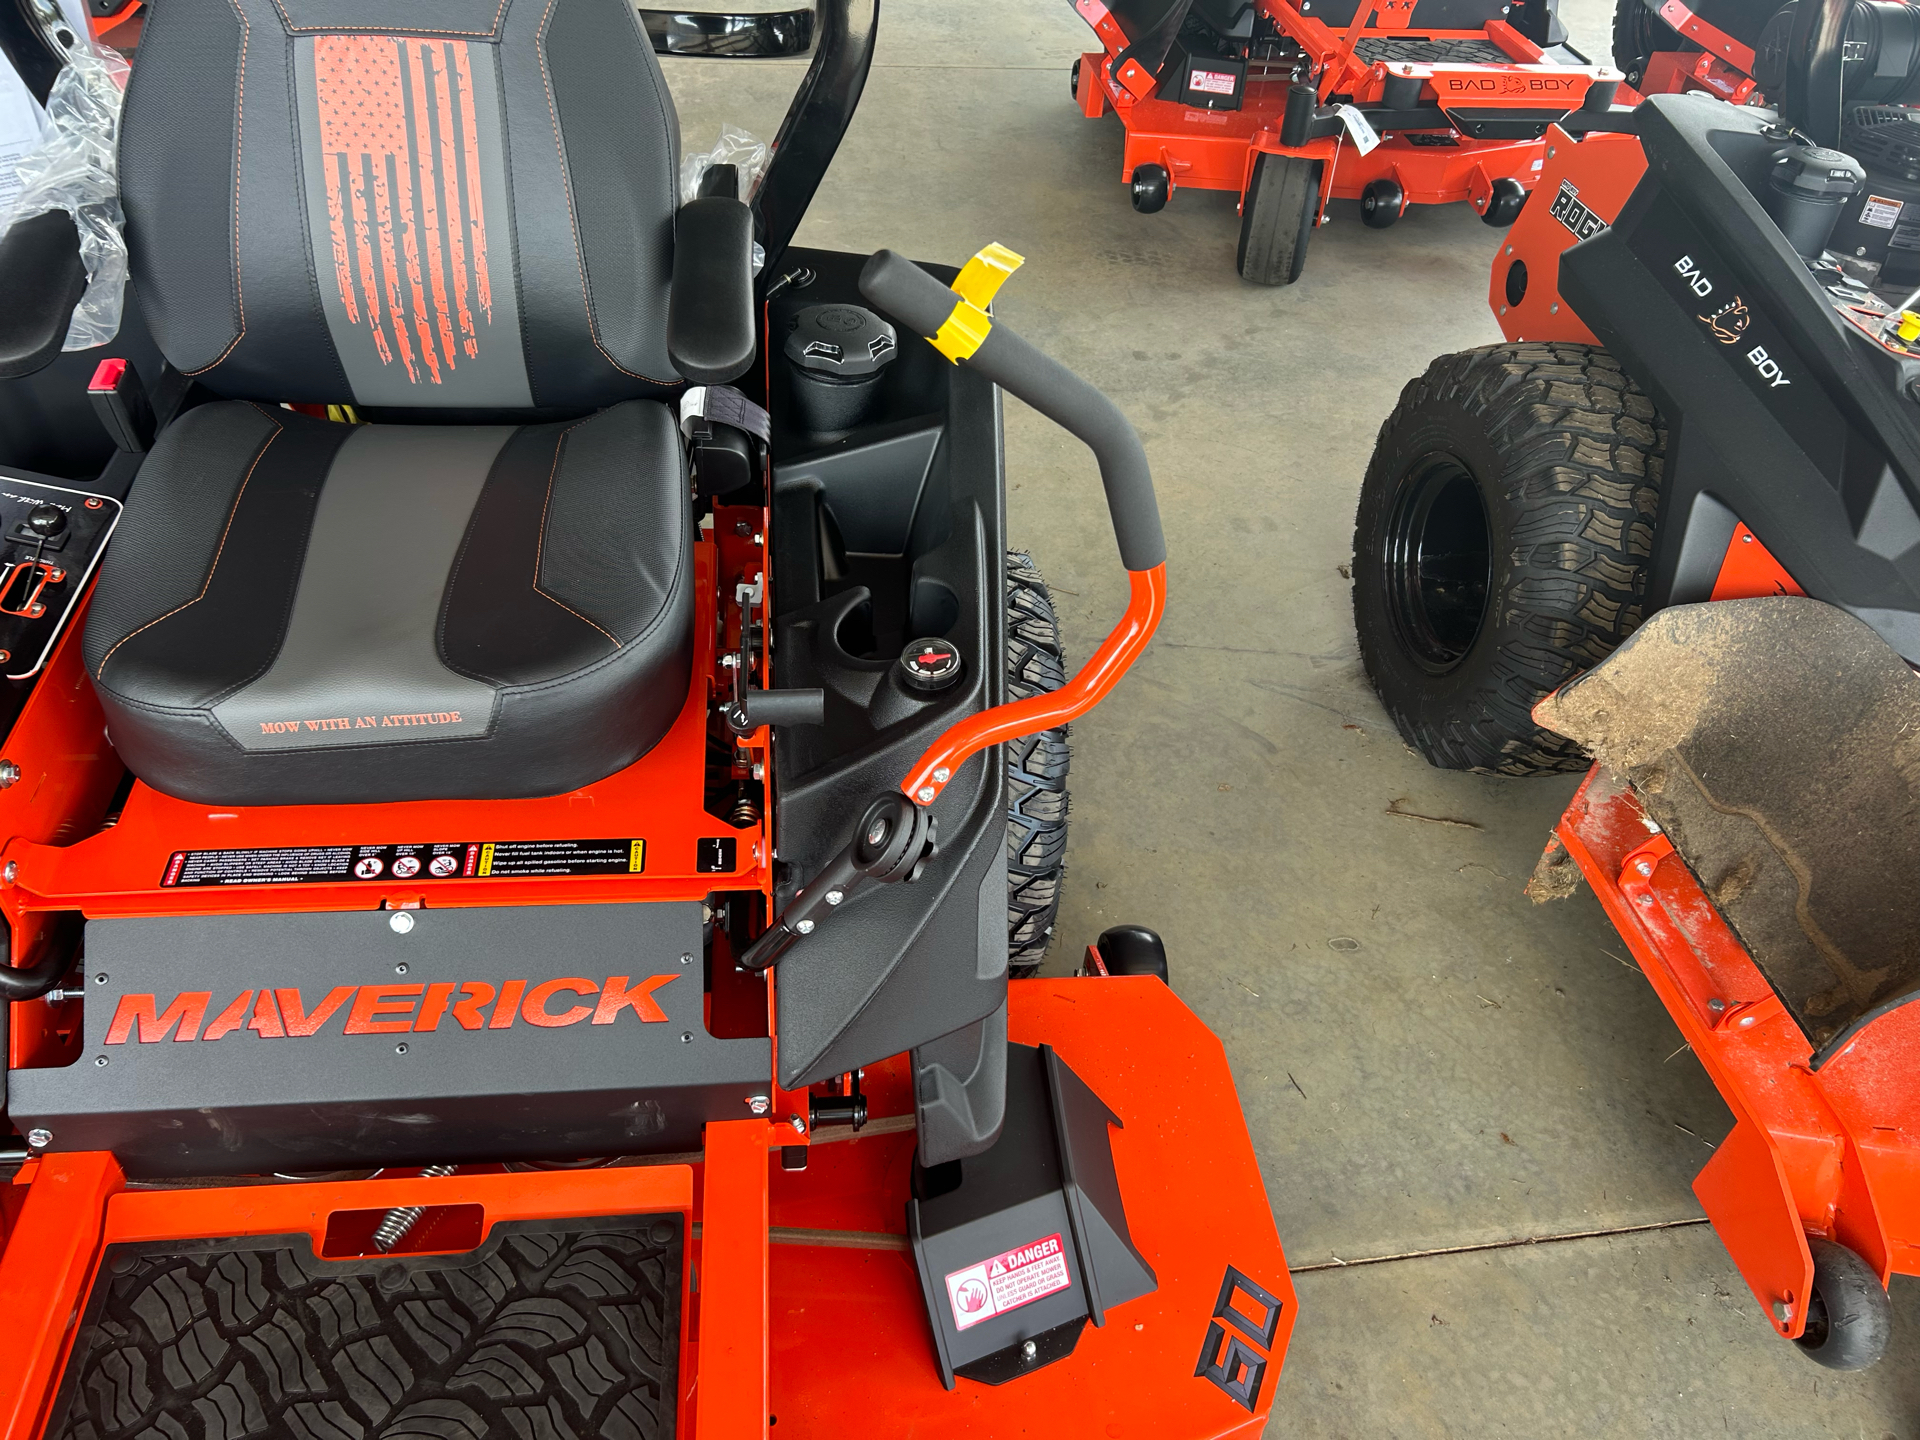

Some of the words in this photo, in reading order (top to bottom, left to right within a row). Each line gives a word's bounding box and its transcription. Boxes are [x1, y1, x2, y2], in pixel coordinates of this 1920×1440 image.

[1449, 80, 1496, 90] BAD
[1530, 79, 1574, 90] BOY
[1549, 186, 1608, 242] ROG
[1674, 255, 1712, 297] BAD
[1747, 346, 1790, 387] BOY
[260, 721, 300, 734] MOW
[304, 718, 351, 732] WITH
[355, 716, 376, 728] AN
[382, 712, 462, 727] ATTITUDE
[482, 851, 490, 874] CAUTION
[105, 974, 682, 1045] MAVERICK
[1008, 1239, 1058, 1270] DANGER
[992, 1277, 1006, 1286] KEEP
[1007, 1269, 1025, 1280] HANDS
[1032, 1262, 1044, 1271] FEET
[997, 1290, 1017, 1301] UNLESS
[1019, 1282, 1036, 1292] GUARD
[1046, 1270, 1064, 1281] GRASS
[1005, 1281, 1015, 1290] NOT
[1017, 1272, 1039, 1285] OPERATE
[1041, 1263, 1062, 1275] MOWER
[1002, 1293, 1026, 1307] CATCHER
[1034, 1279, 1062, 1294] ATTACHED.
[1194, 1264, 1284, 1414] 60
